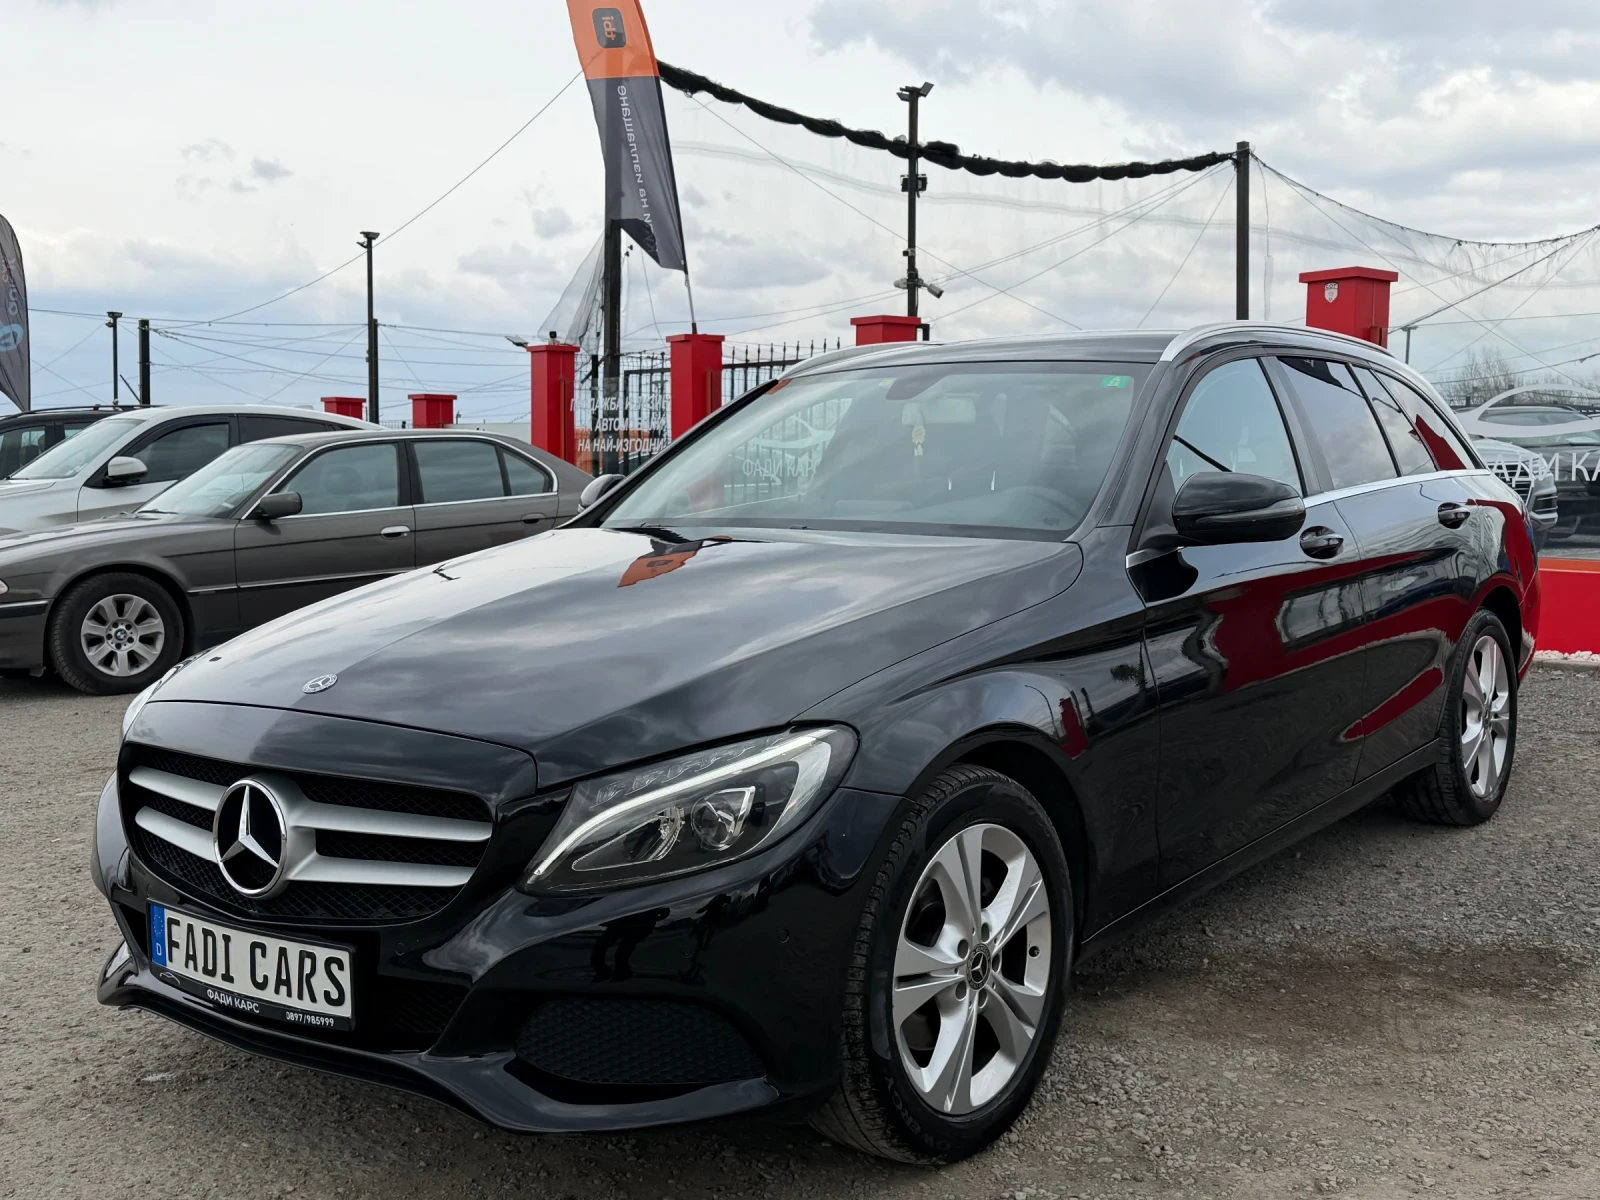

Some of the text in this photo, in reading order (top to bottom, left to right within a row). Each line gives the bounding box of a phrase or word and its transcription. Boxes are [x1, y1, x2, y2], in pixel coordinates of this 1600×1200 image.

[578, 438, 591, 452] НА
[742, 458, 783, 481] ФАДИ
[1491, 452, 1560, 488] АДИ
[156, 942, 162, 957] D
[166, 916, 346, 1008] FADI CARS
[206, 989, 260, 1013] ФАДИ КАРС
[285, 1011, 334, 1027] 0897/985999
